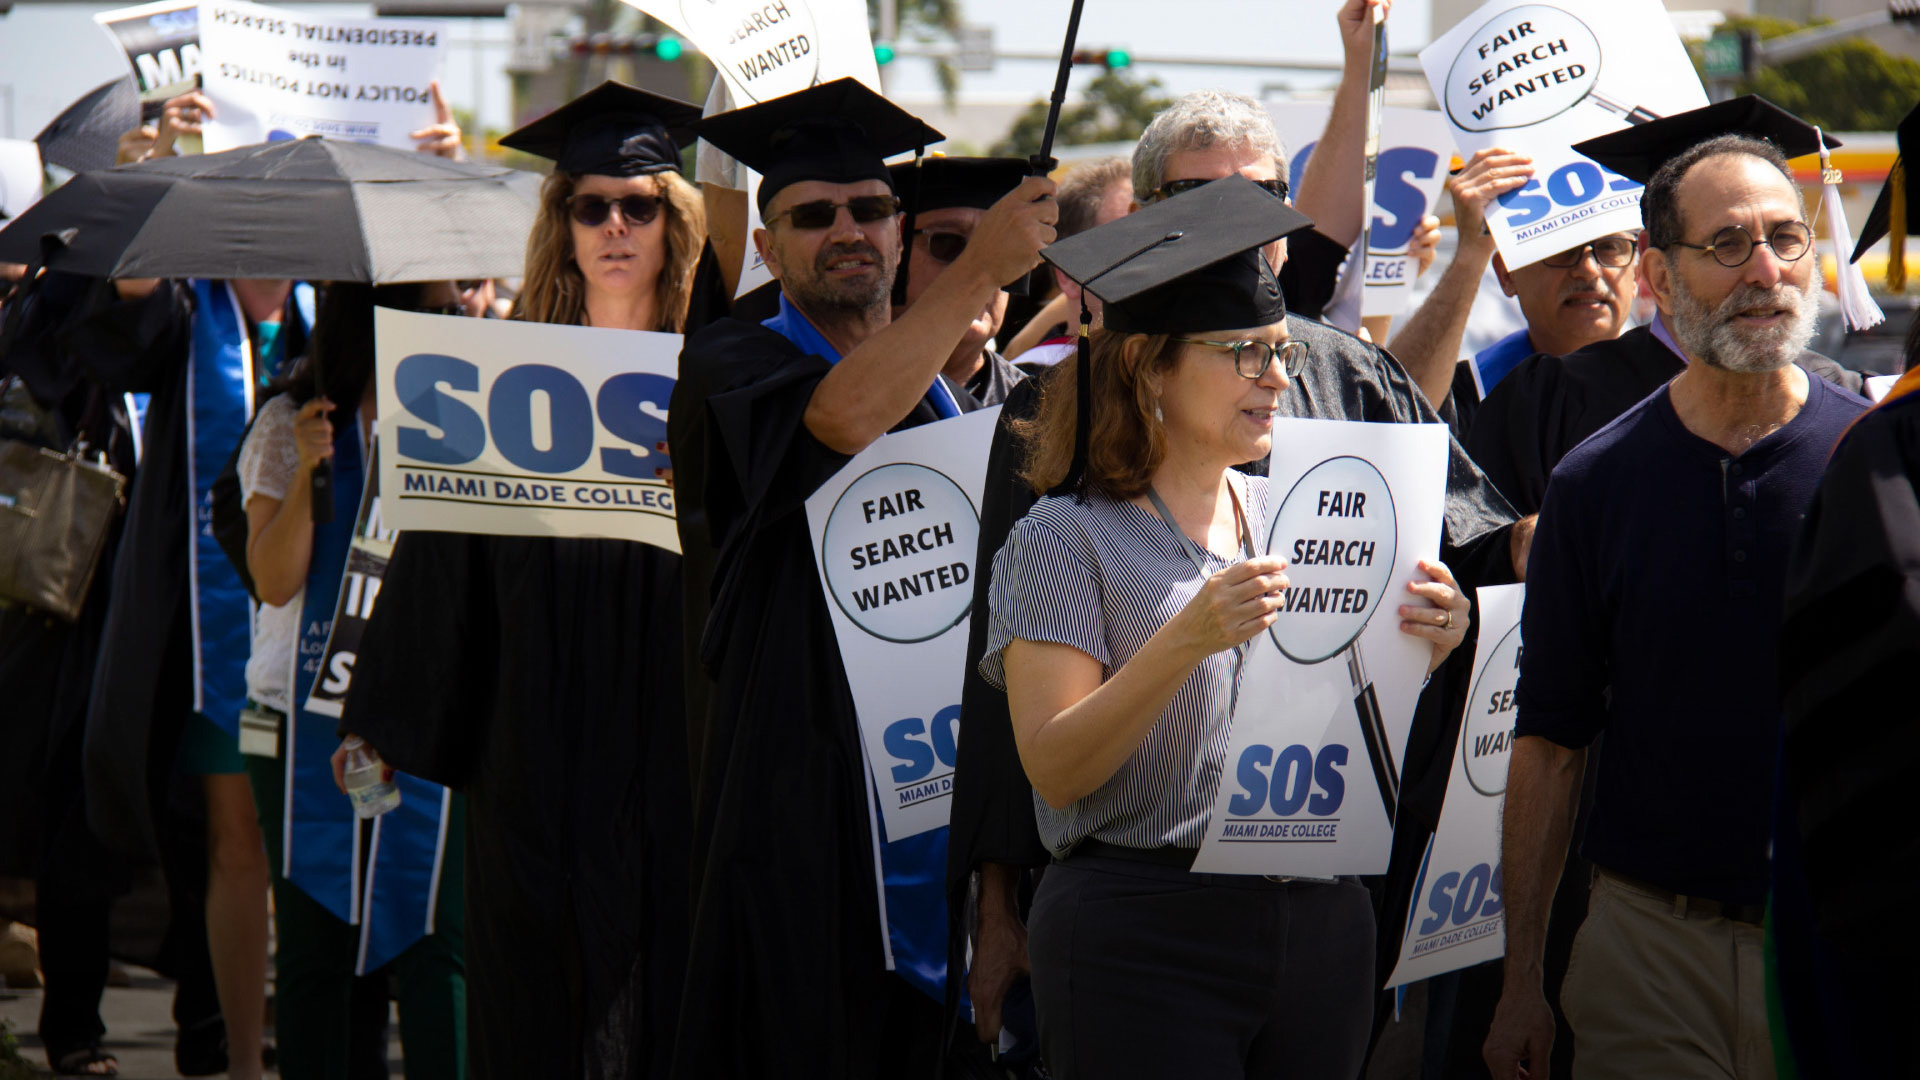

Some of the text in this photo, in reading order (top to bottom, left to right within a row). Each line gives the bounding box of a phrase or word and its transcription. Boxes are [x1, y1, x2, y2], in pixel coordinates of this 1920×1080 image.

[214, 8, 286, 35] SEARCH
[293, 22, 438, 47] PRESIDENTIAL
[737, 33, 811, 82] WANTED
[1477, 21, 1537, 61] FAIR
[288, 50, 347, 72] in the
[1468, 38, 1569, 96] SEARCH
[219, 62, 432, 104] POLICY NOT POLITICS
[1471, 63, 1586, 121] WANTED
[1515, 219, 1558, 241] MIAMI
[1560, 204, 1598, 225] DADE
[394, 352, 678, 480] SOS
[404, 472, 674, 511] MIAMI DADE COLLEG
[862, 488, 926, 525] FAIR
[1316, 490, 1367, 518] FAIR
[850, 521, 955, 571] SEARCH
[1291, 538, 1376, 567] SEARCH
[851, 561, 970, 613] WANTED
[1276, 586, 1369, 614] WANTED
[899, 781, 940, 805] MIAMI
[1227, 743, 1350, 817] SOS
[1222, 823, 1338, 838] MIAMI DADE COLLEGE
[1418, 862, 1505, 936] SOS
[1412, 919, 1501, 956] MIAMI DADE COLLEGE
